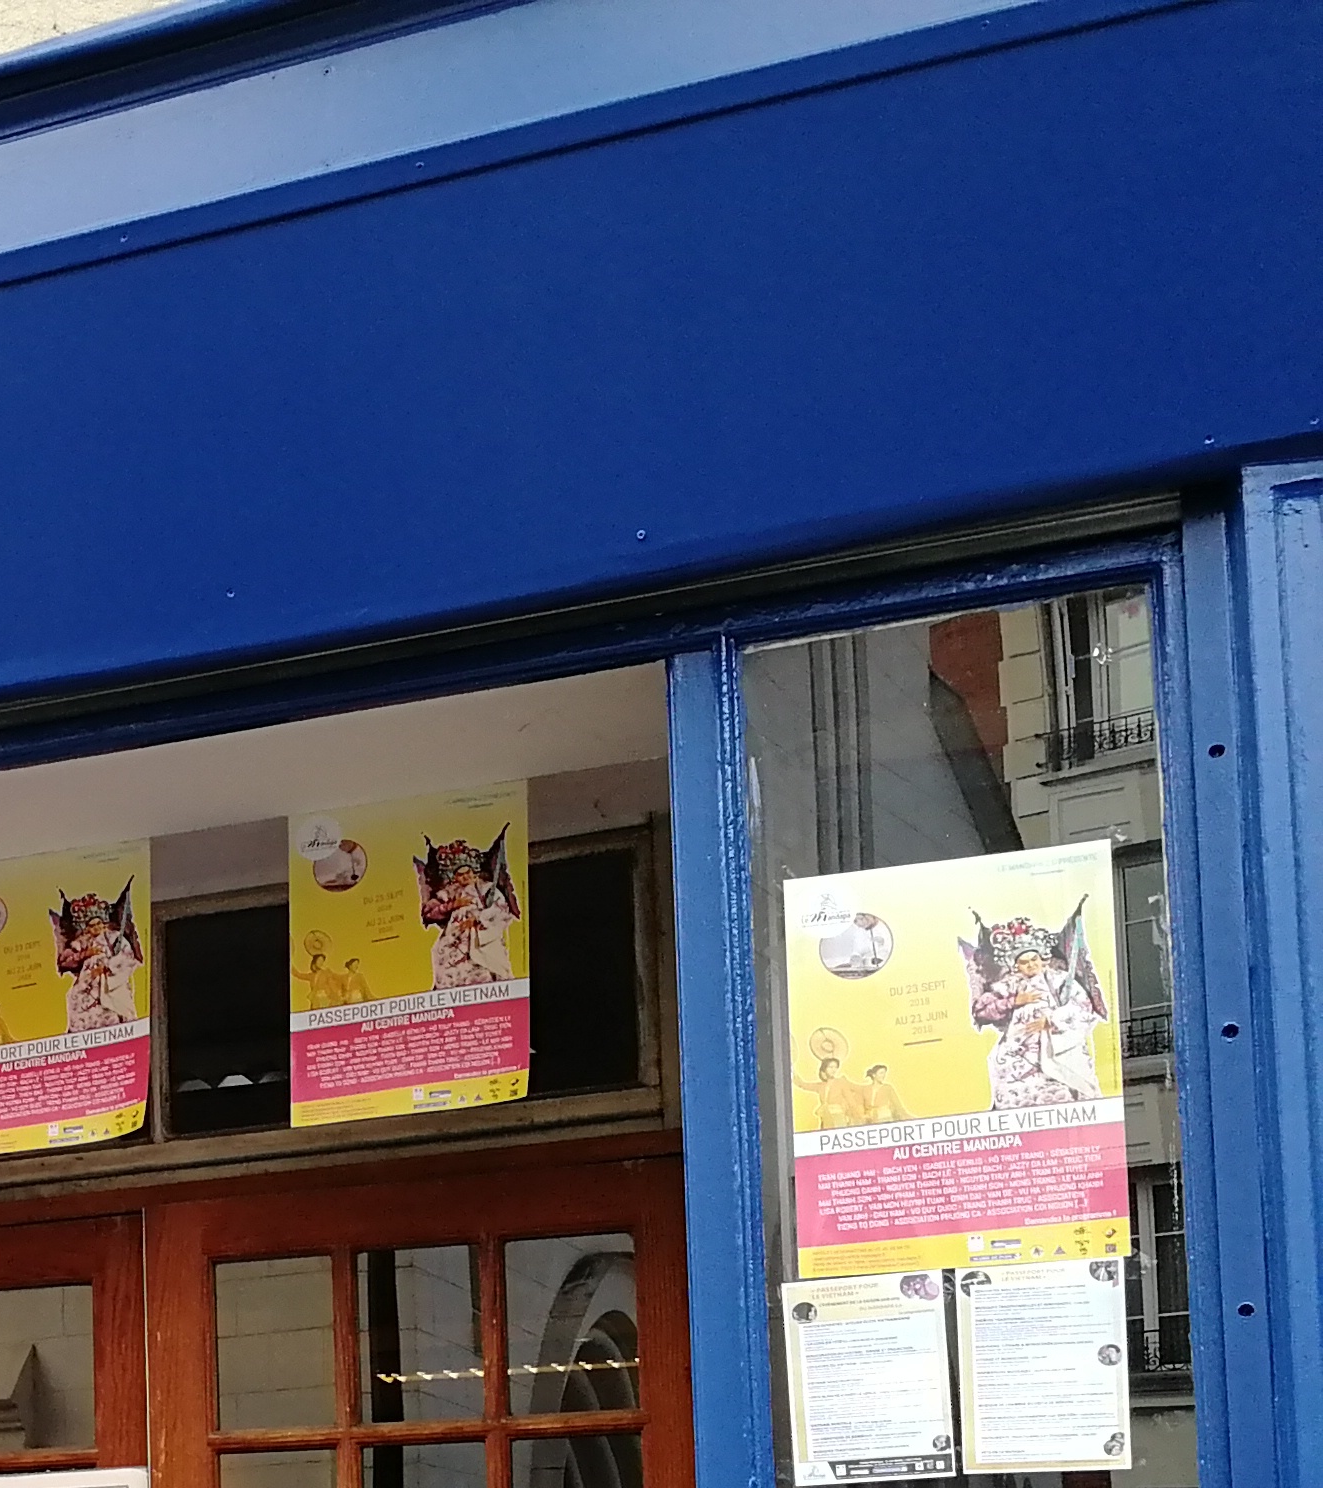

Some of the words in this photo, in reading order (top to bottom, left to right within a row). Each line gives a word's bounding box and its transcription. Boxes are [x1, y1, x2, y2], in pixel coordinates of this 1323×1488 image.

[889, 986, 904, 997] DU
[906, 984, 919, 994] 23
[921, 979, 947, 992] SEPT
[309, 1002, 384, 1027] PASSEPORT
[389, 995, 425, 1014] POUR
[430, 991, 446, 1006] LE
[450, 984, 510, 1004] VIETNAM
[909, 997, 930, 1007] 2018
[361, 1020, 374, 1033] AU
[375, 1015, 410, 1030] CENTRE
[411, 1008, 455, 1025] MANDAPA
[895, 1016, 908, 1026] AU
[910, 1013, 922, 1023] 21
[926, 1009, 948, 1021] JUIN
[27, 1038, 60, 1055] POUR
[64, 1035, 78, 1049] LE
[83, 1025, 134, 1046] VIETNAM
[1, 1061, 13, 1073] AU
[14, 1056, 47, 1071] CENTRE
[48, 1050, 87, 1066] MANDAPA
[819, 1123, 926, 1151] PASSEPORT
[931, 1116, 981, 1139] POUR
[988, 1113, 1010, 1132] LE
[1015, 1105, 1097, 1129] VIETNAM
[893, 1146, 910, 1161] AU
[912, 1141, 962, 1158] CENTRE
[964, 1134, 1023, 1153] MANDAPA
[817, 1284, 857, 1293] PASSEPORT
[821, 1291, 854, 1299] VIETNAM
